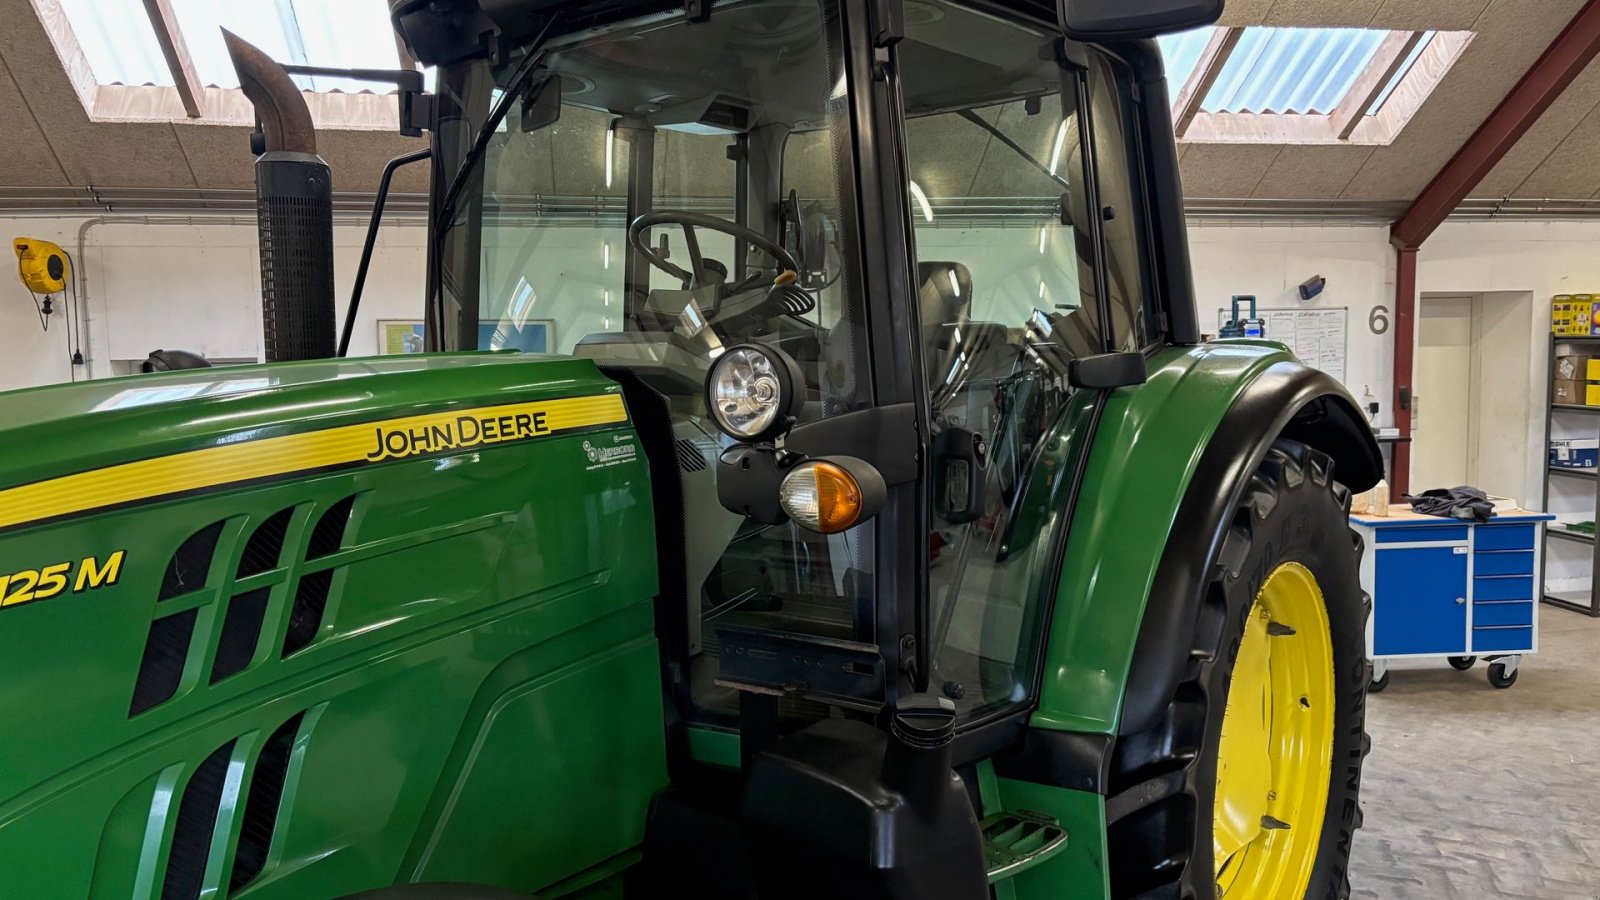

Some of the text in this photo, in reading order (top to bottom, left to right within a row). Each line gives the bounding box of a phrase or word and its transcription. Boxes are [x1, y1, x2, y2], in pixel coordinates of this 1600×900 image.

[1369, 305, 1389, 335] 6
[368, 412, 548, 458] JOHN DEERE
[1325, 631, 1363, 900] CONTINENTA
